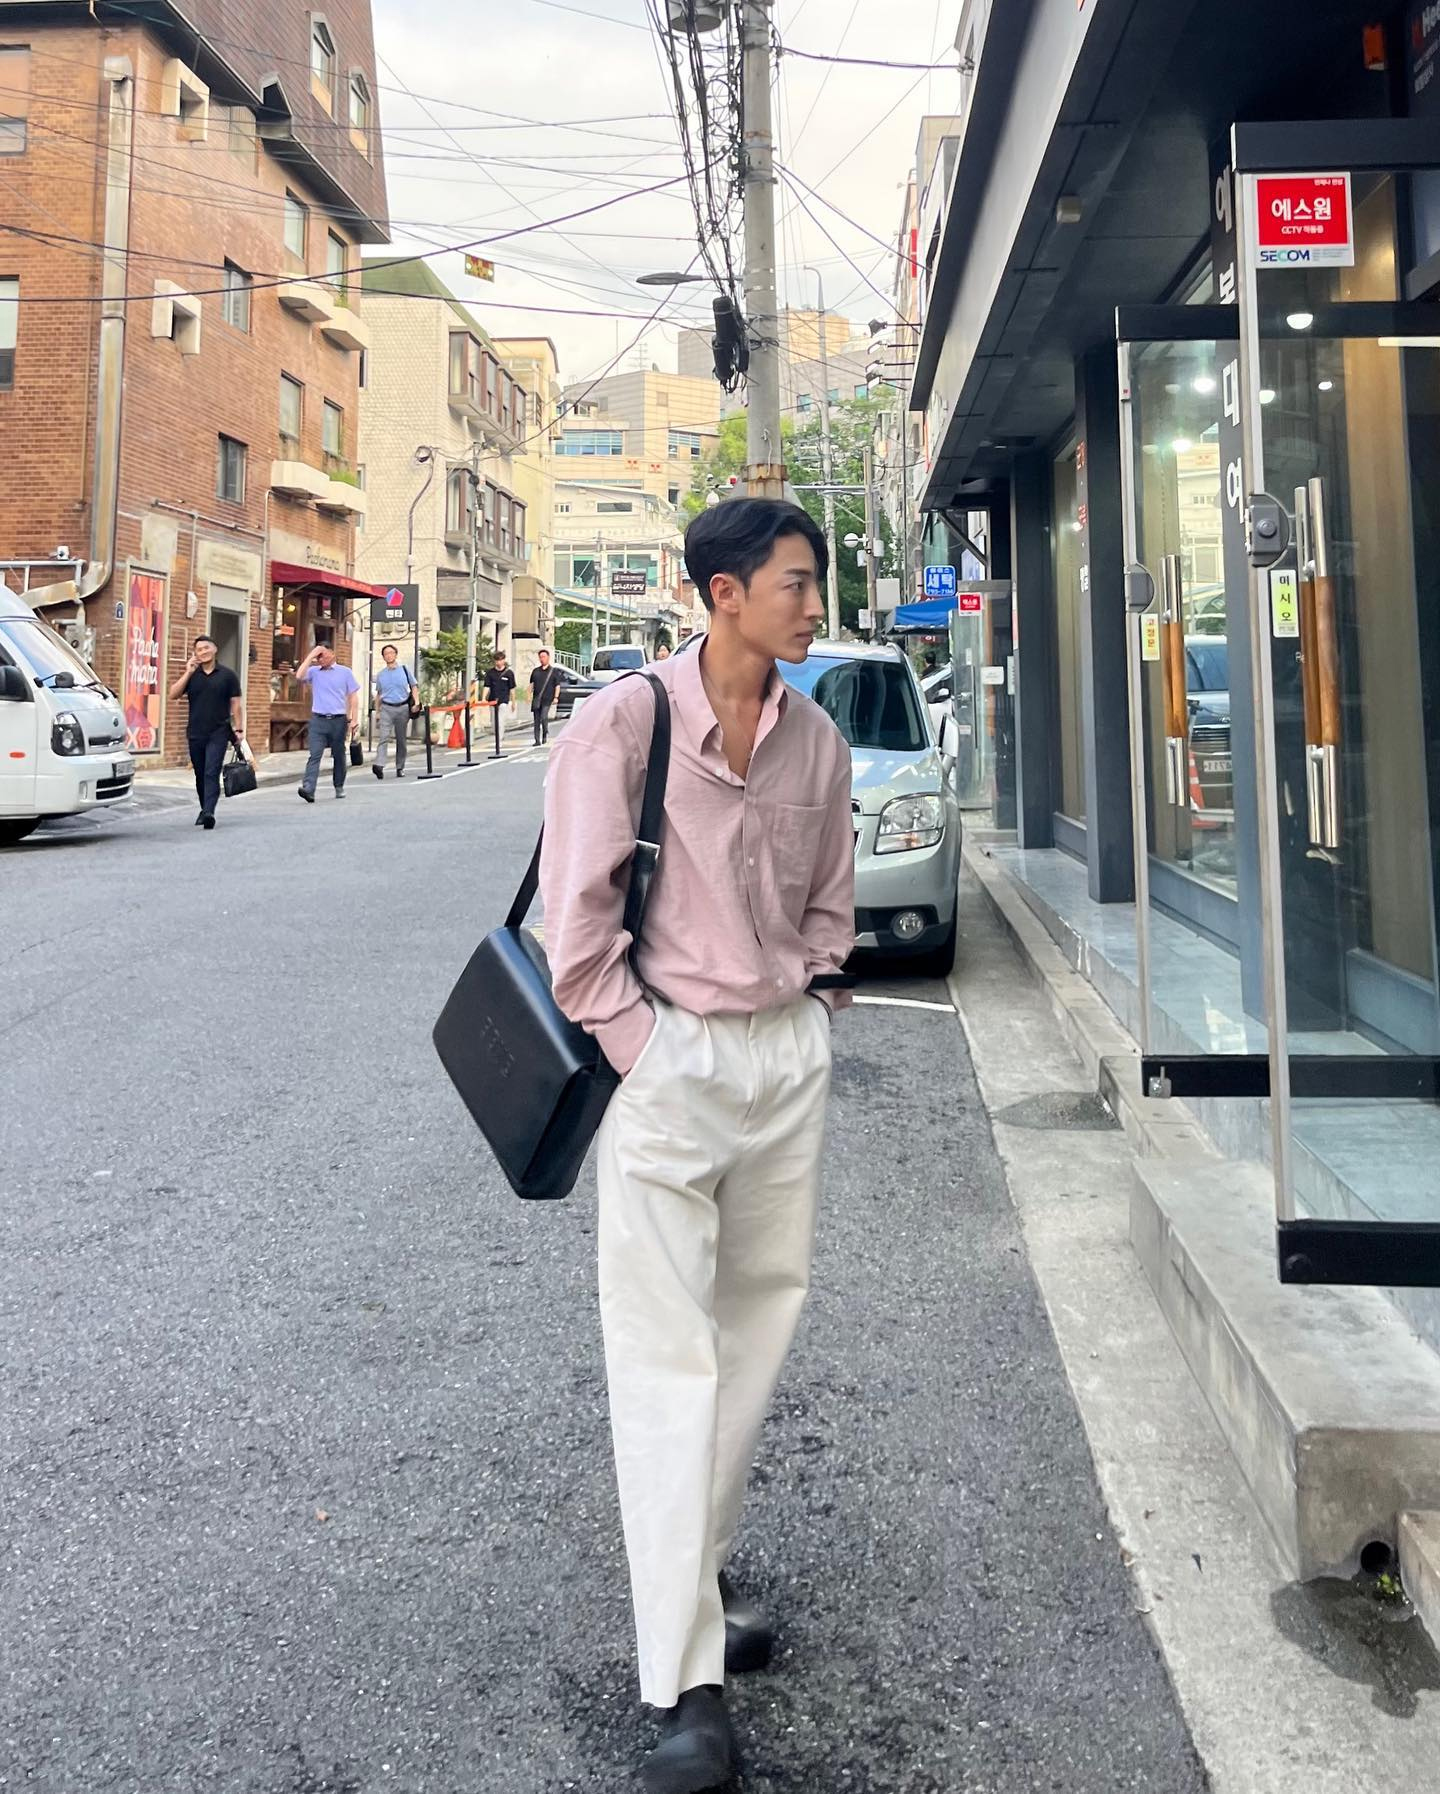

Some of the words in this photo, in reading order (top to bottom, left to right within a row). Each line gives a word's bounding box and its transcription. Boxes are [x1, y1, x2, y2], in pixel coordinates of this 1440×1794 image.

[1271, 197, 1331, 221] 에스원
[1281, 225, 1302, 234] CCTV
[1260, 250, 1310, 262] SECOM
[927, 574, 953, 588] 세탁
[1279, 575, 1292, 622] 미시오
